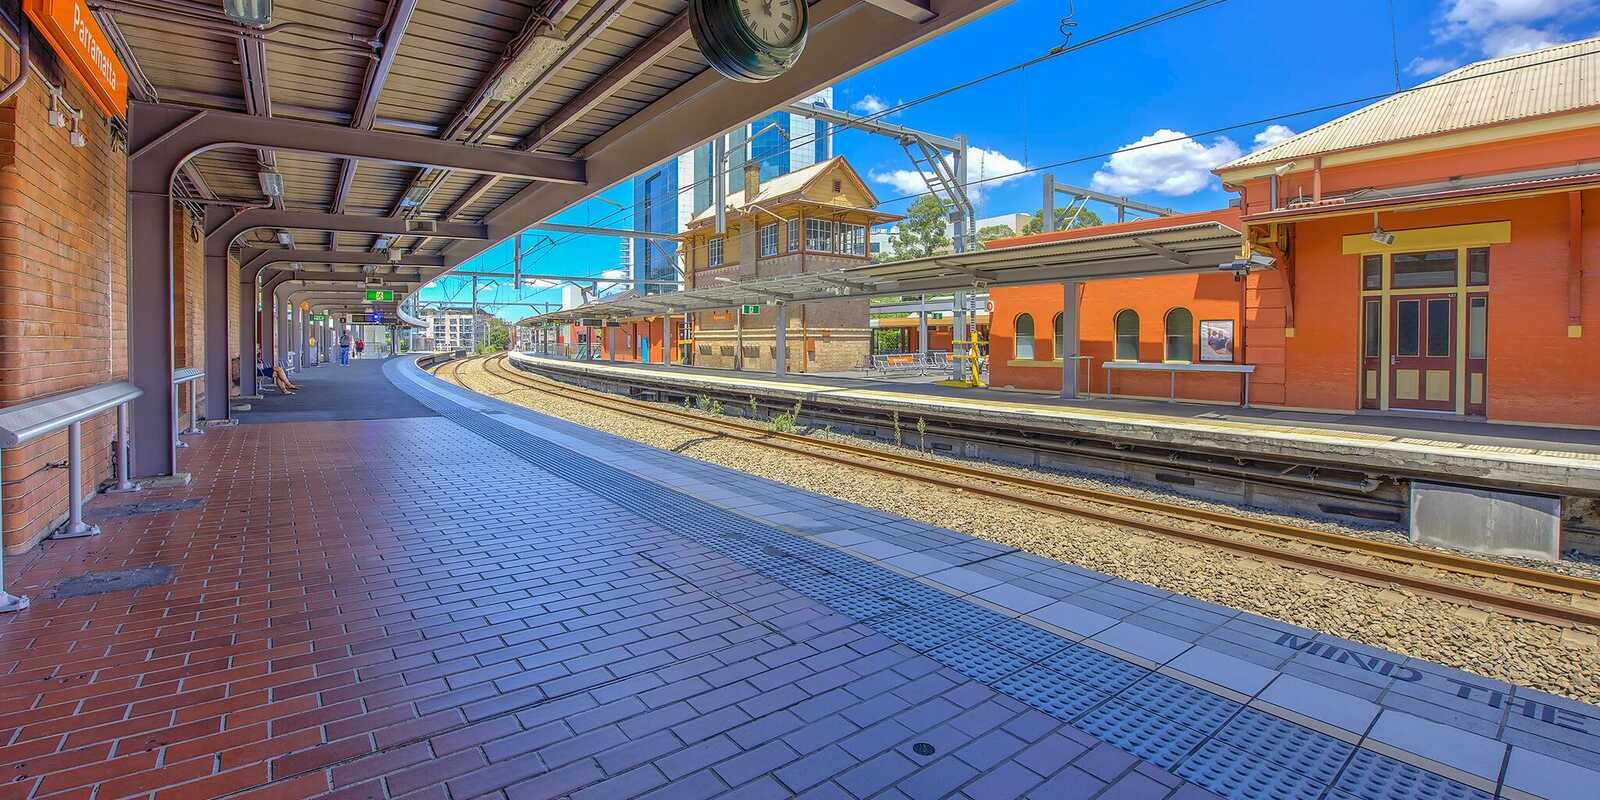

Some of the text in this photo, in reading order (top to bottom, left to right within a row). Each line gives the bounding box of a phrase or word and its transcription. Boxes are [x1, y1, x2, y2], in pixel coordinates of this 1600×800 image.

[73, 3, 116, 91] Parramatta
[1275, 632, 1589, 734] MIND THE
